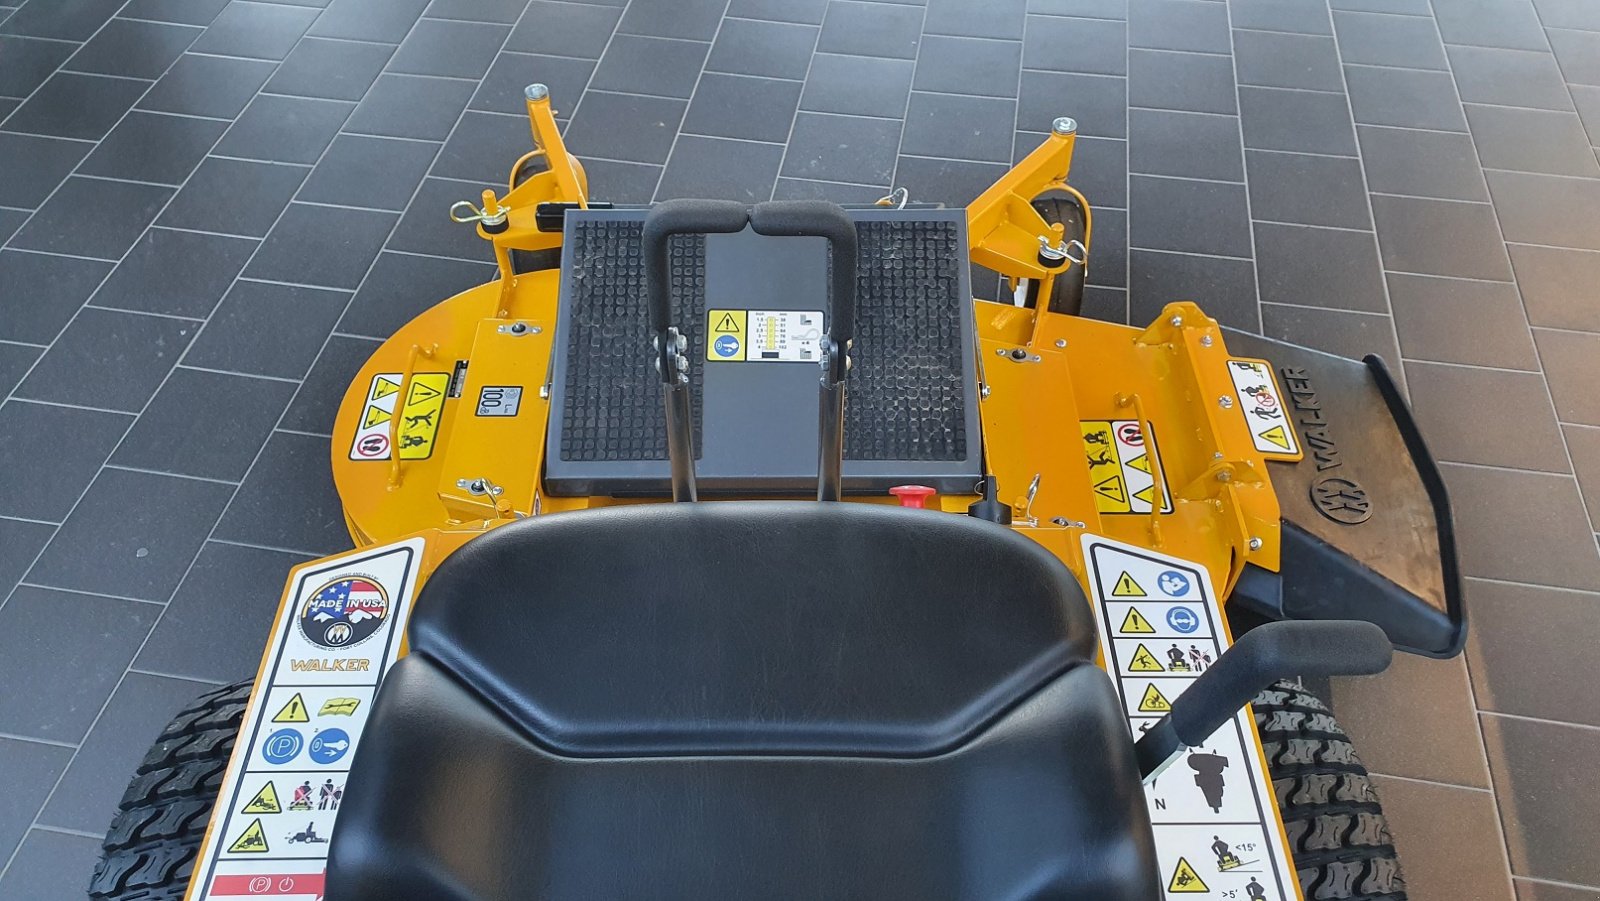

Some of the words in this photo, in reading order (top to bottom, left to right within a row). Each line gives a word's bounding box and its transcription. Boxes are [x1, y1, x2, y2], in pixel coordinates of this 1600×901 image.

[481, 388, 504, 408] 100
[1281, 367, 1343, 473] WALKER
[308, 599, 344, 608] MADE
[346, 599, 360, 608] IN
[362, 599, 387, 608] USA
[290, 659, 370, 672] WALKER
[1155, 798, 1166, 810] N
